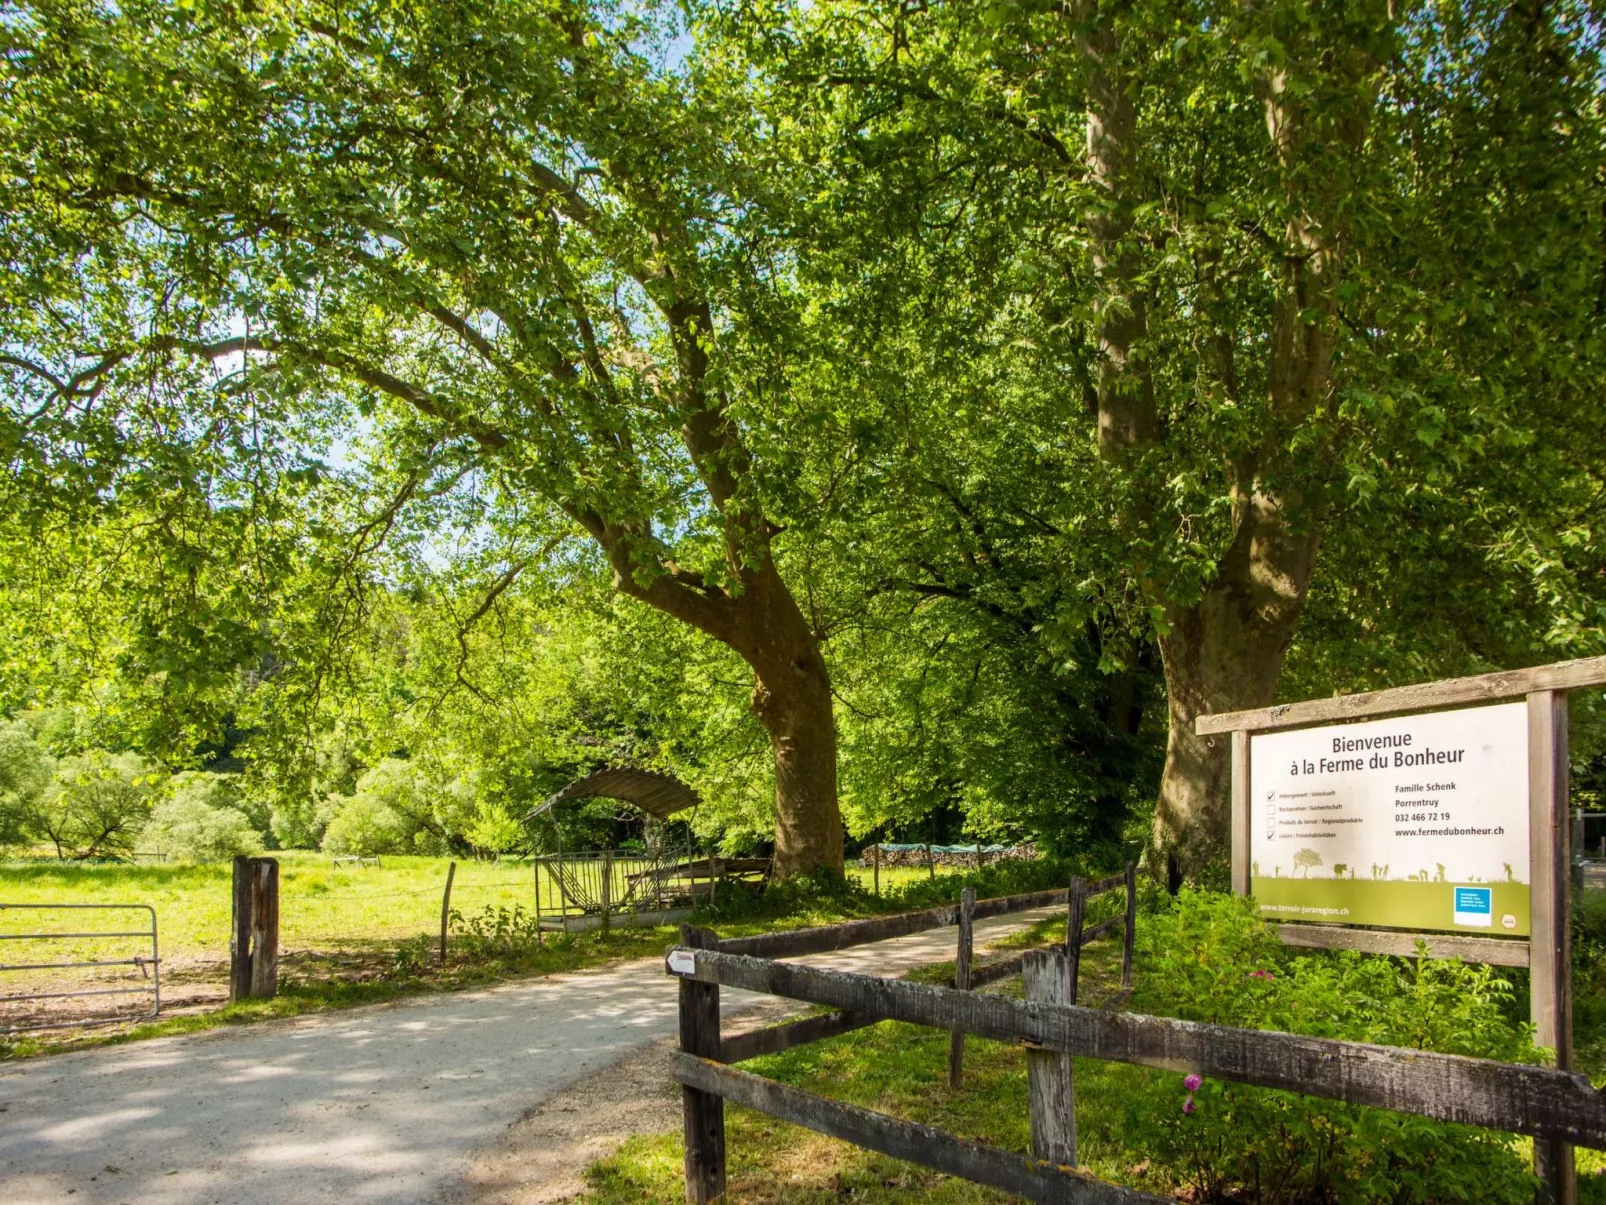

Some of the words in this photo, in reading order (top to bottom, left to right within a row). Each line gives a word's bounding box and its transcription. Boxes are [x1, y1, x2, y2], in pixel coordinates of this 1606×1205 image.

[1332, 734, 1412, 753] Bienvenue
[1290, 760, 1298, 776] à
[1303, 760, 1315, 774] la
[1320, 758, 1364, 773] Ferme
[1369, 752, 1388, 769] du
[1394, 748, 1465, 768] Bonheur
[1395, 783, 1424, 793] Famille
[1426, 782, 1456, 791] Schenk
[1395, 799, 1439, 808] Porrentruy
[1395, 814, 1409, 822] 032
[1411, 813, 1426, 822] 466
[1428, 813, 1438, 821] 72
[1440, 812, 1450, 820] 19
[1395, 826, 1504, 836] www.fermedubonheur.ch
[1260, 905, 1349, 916] www.terroir-juraregion.ch
